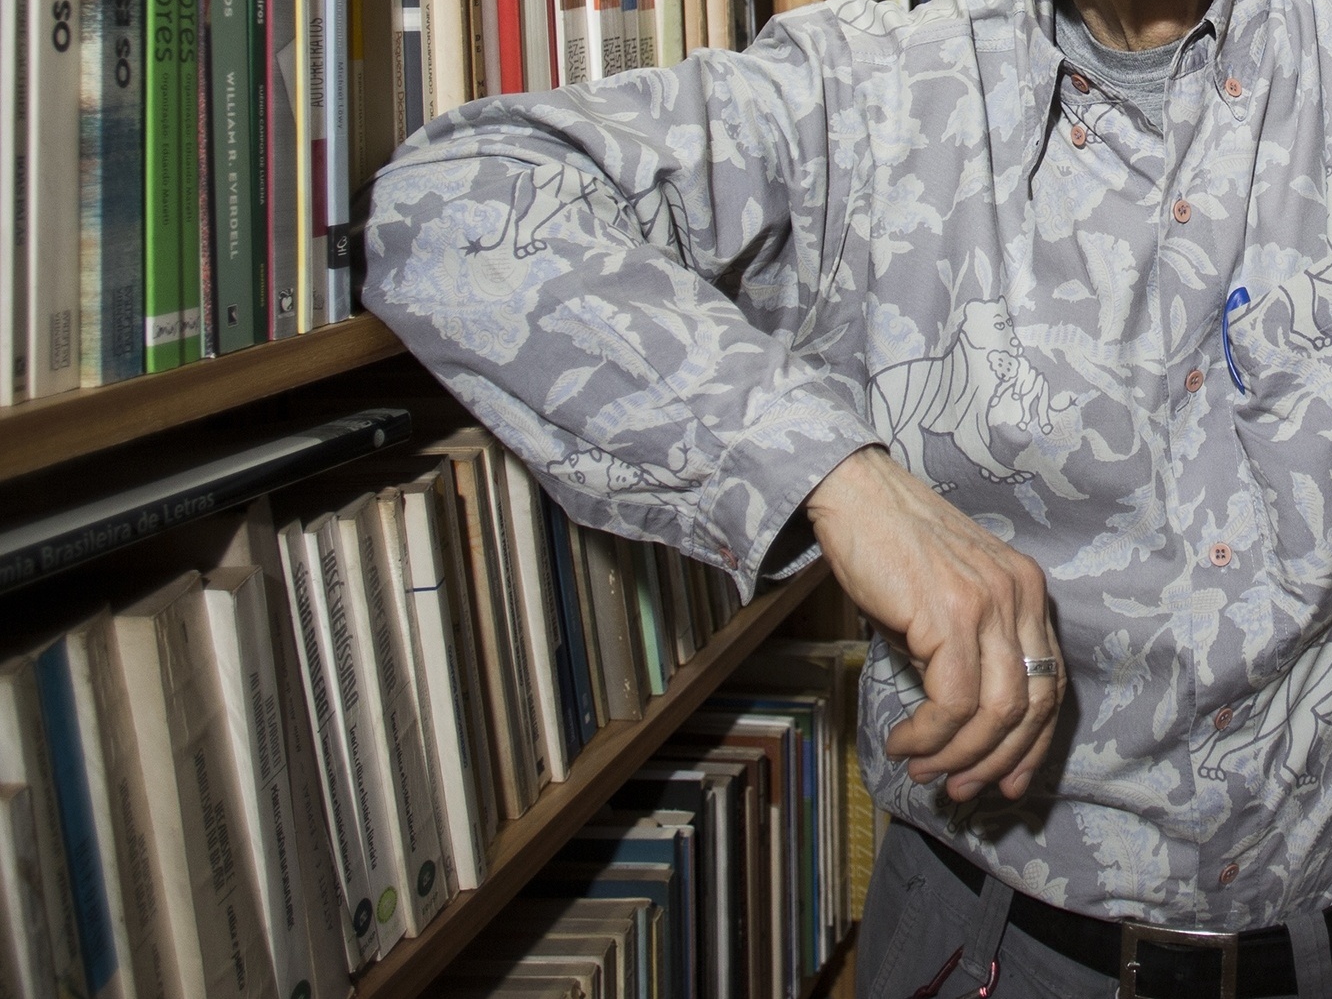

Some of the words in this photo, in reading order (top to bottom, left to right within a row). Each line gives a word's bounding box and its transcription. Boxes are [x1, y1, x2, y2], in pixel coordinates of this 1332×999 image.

[50, 0, 70, 52] OS
[112, 36, 130, 88] OS
[309, 16, 322, 107] AUTO-RETRATOS
[424, 3, 433, 94] CONTEMPORÂNEA
[225, 71, 236, 143] WILLIAM
[226, 150, 237, 166] R.
[227, 172, 239, 259] EVERDELL
[318, 548, 342, 597] JOSÉ
[327, 595, 362, 710] VERÍSSIMO
